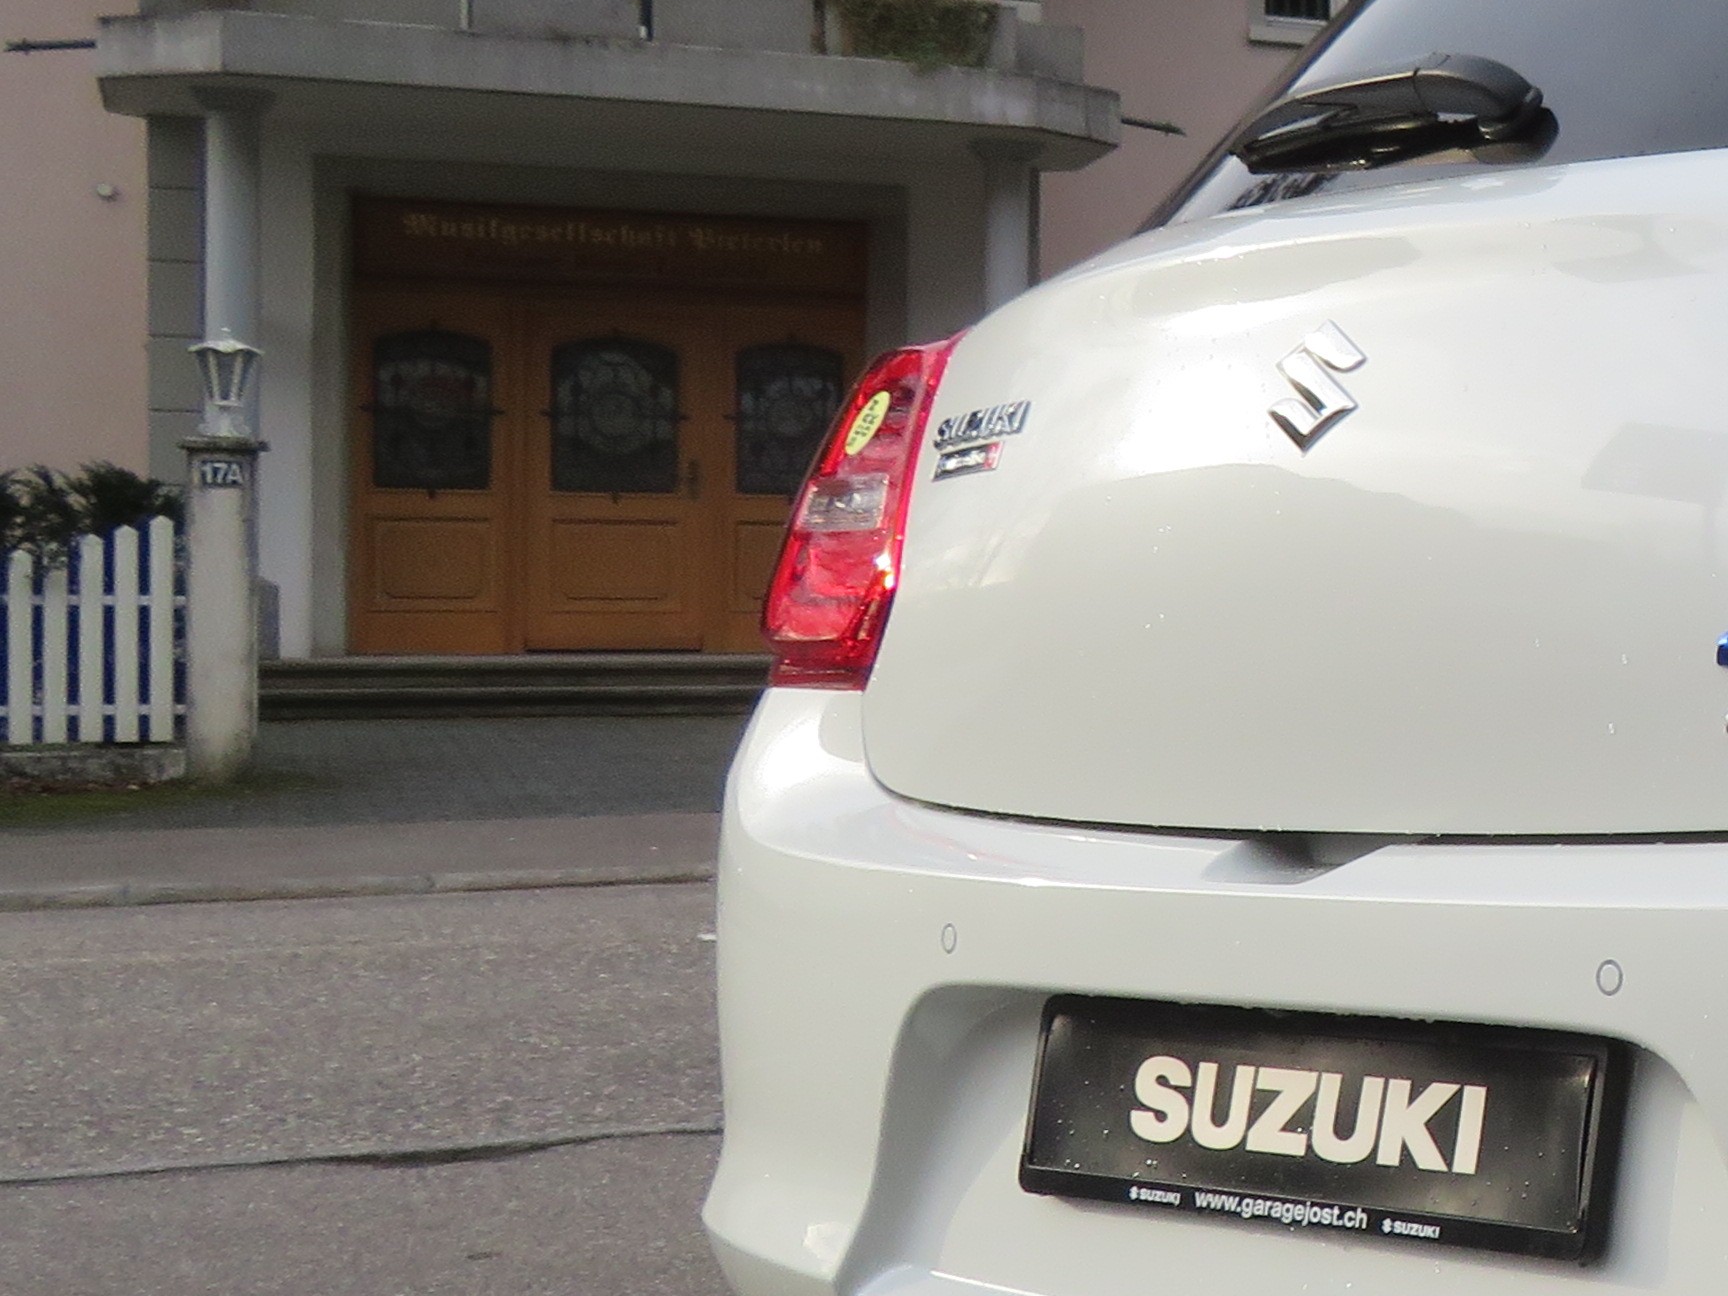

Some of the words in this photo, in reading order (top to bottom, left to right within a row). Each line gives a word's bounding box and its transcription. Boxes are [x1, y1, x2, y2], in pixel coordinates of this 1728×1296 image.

[201, 463, 243, 483] 17A
[1129, 1055, 1488, 1175] SUZUKI
[1139, 1188, 1181, 1206] SUZUKI
[1195, 1191, 1367, 1229] www.garagejost.ch
[1393, 1221, 1440, 1239] SUZUKI
